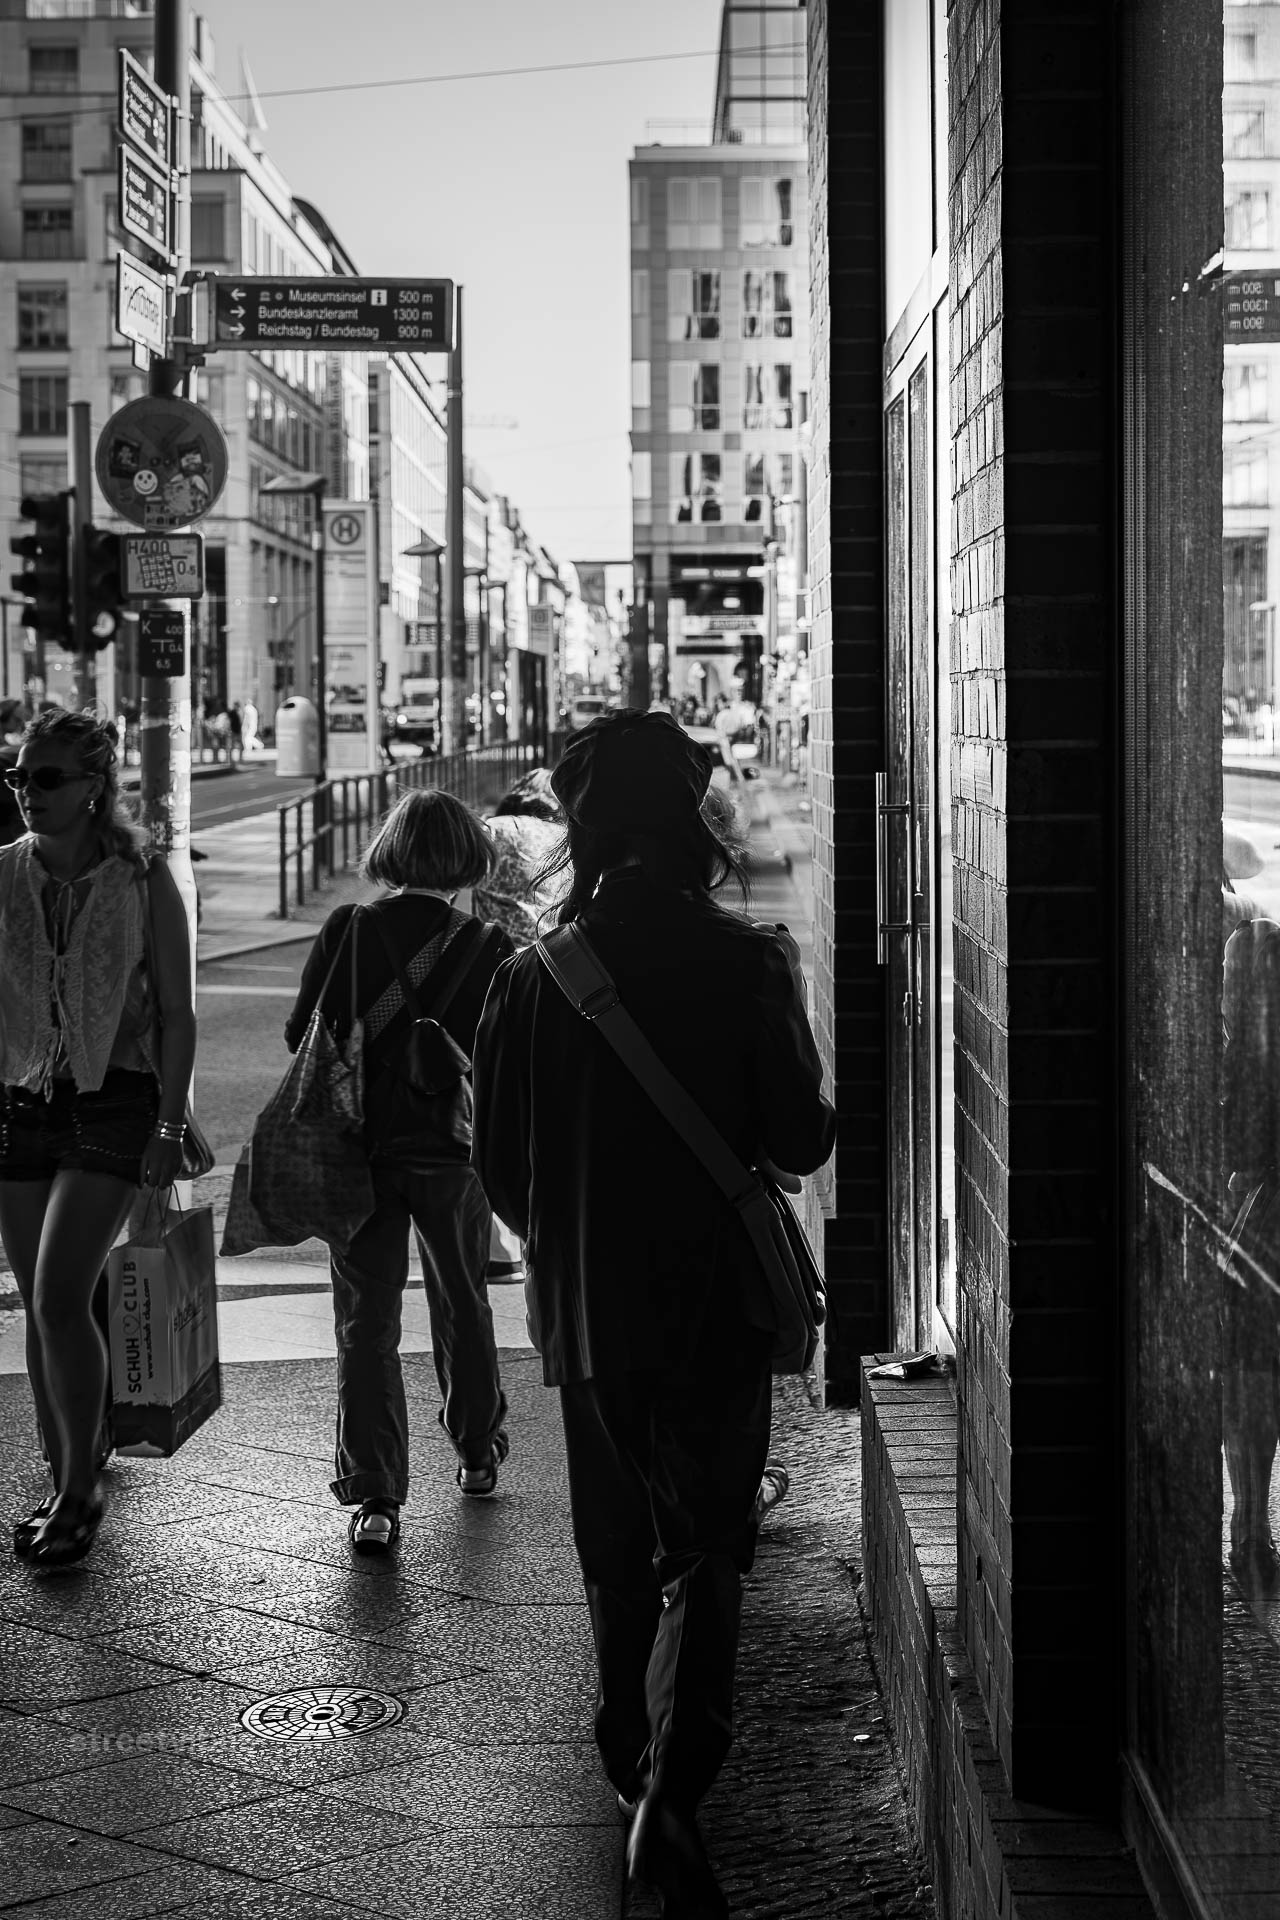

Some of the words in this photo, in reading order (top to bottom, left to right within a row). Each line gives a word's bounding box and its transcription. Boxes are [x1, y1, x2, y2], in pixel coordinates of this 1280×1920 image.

[288, 289, 366, 303] Museumsinsel
[399, 291, 420, 303] 500
[421, 294, 433, 303] m
[258, 306, 359, 320] Bundeskanzleramt
[393, 308, 420, 321] 1300
[421, 311, 433, 320] m
[258, 323, 312, 339] Reichstag
[321, 324, 380, 340] Bundestag
[398, 325, 419, 338] 900
[421, 329, 433, 338] m
[141, 619, 151, 634] K
[123, 1260, 137, 1312] CLUB
[126, 1338, 142, 1393] SCHUH
